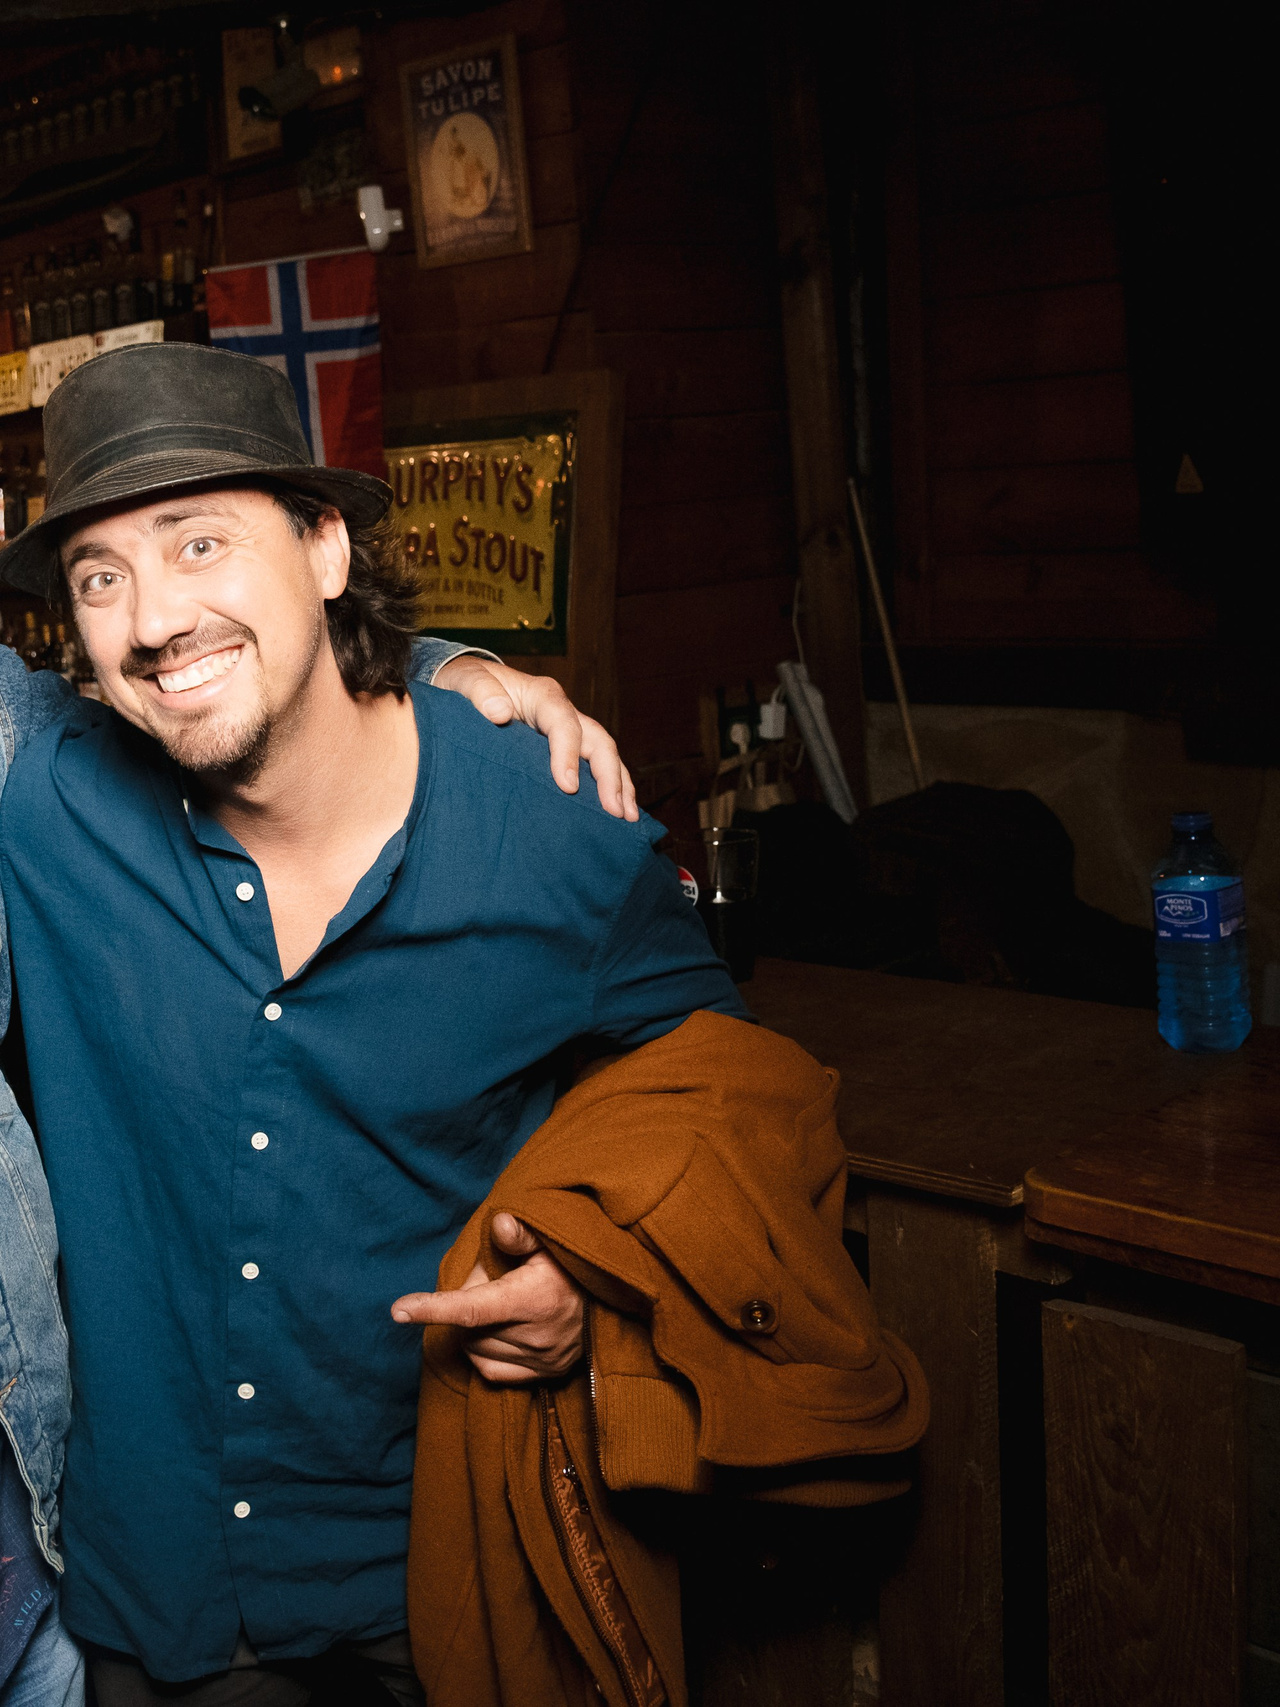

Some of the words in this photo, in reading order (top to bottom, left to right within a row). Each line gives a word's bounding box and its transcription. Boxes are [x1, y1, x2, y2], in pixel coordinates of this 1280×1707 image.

[420, 59, 493, 97] SAVON
[417, 82, 503, 119] TULIPE
[404, 529, 440, 567] RA
[449, 518, 545, 592] STOUT
[1166, 897, 1193, 906] MONTE
